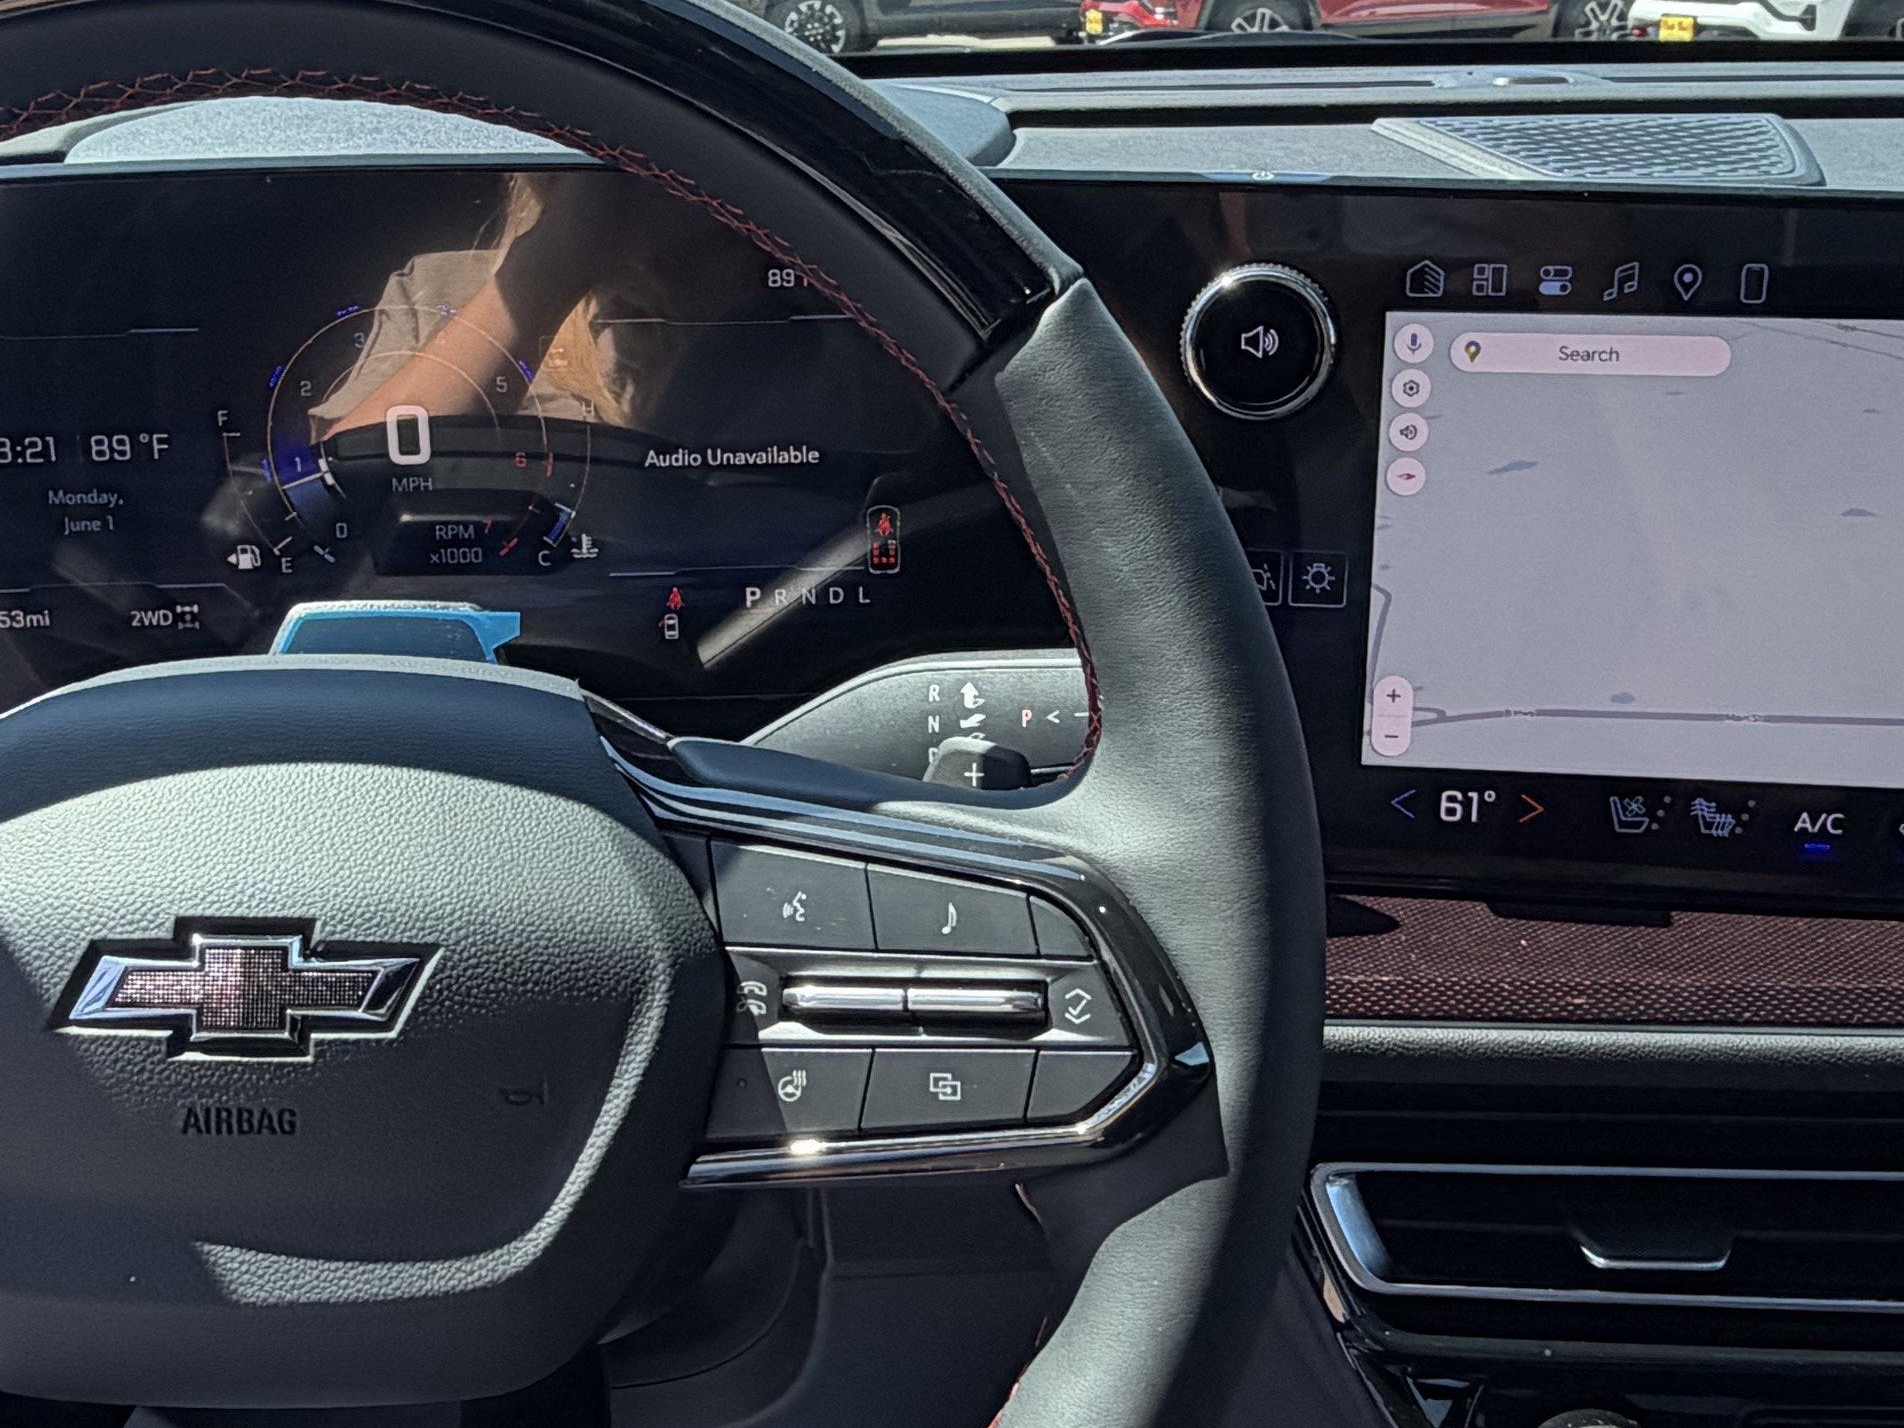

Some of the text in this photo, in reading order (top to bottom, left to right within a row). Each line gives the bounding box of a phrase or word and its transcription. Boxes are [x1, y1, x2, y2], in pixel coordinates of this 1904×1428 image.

[353, 332, 366, 349] 3
[1557, 344, 1621, 364] Search
[299, 381, 313, 397] 2
[495, 376, 509, 394] 5
[217, 410, 229, 427] F
[385, 404, 431, 466] 0
[644, 444, 820, 468] Audio Unavailable
[391, 477, 433, 492] MPH
[63, 515, 114, 535] June 1
[434, 524, 475, 540] RPM
[281, 557, 293, 573] E
[429, 548, 484, 564] x1000
[537, 550, 552, 567] C
[745, 586, 871, 608] P R N D L
[130, 609, 173, 628] 2WD
[928, 684, 941, 703] R
[928, 715, 940, 735] N
[1022, 708, 1032, 728] P
[1439, 789, 1496, 824] 61°
[1794, 813, 1845, 836] A/C
[181, 1106, 297, 1137] AIRBAG
